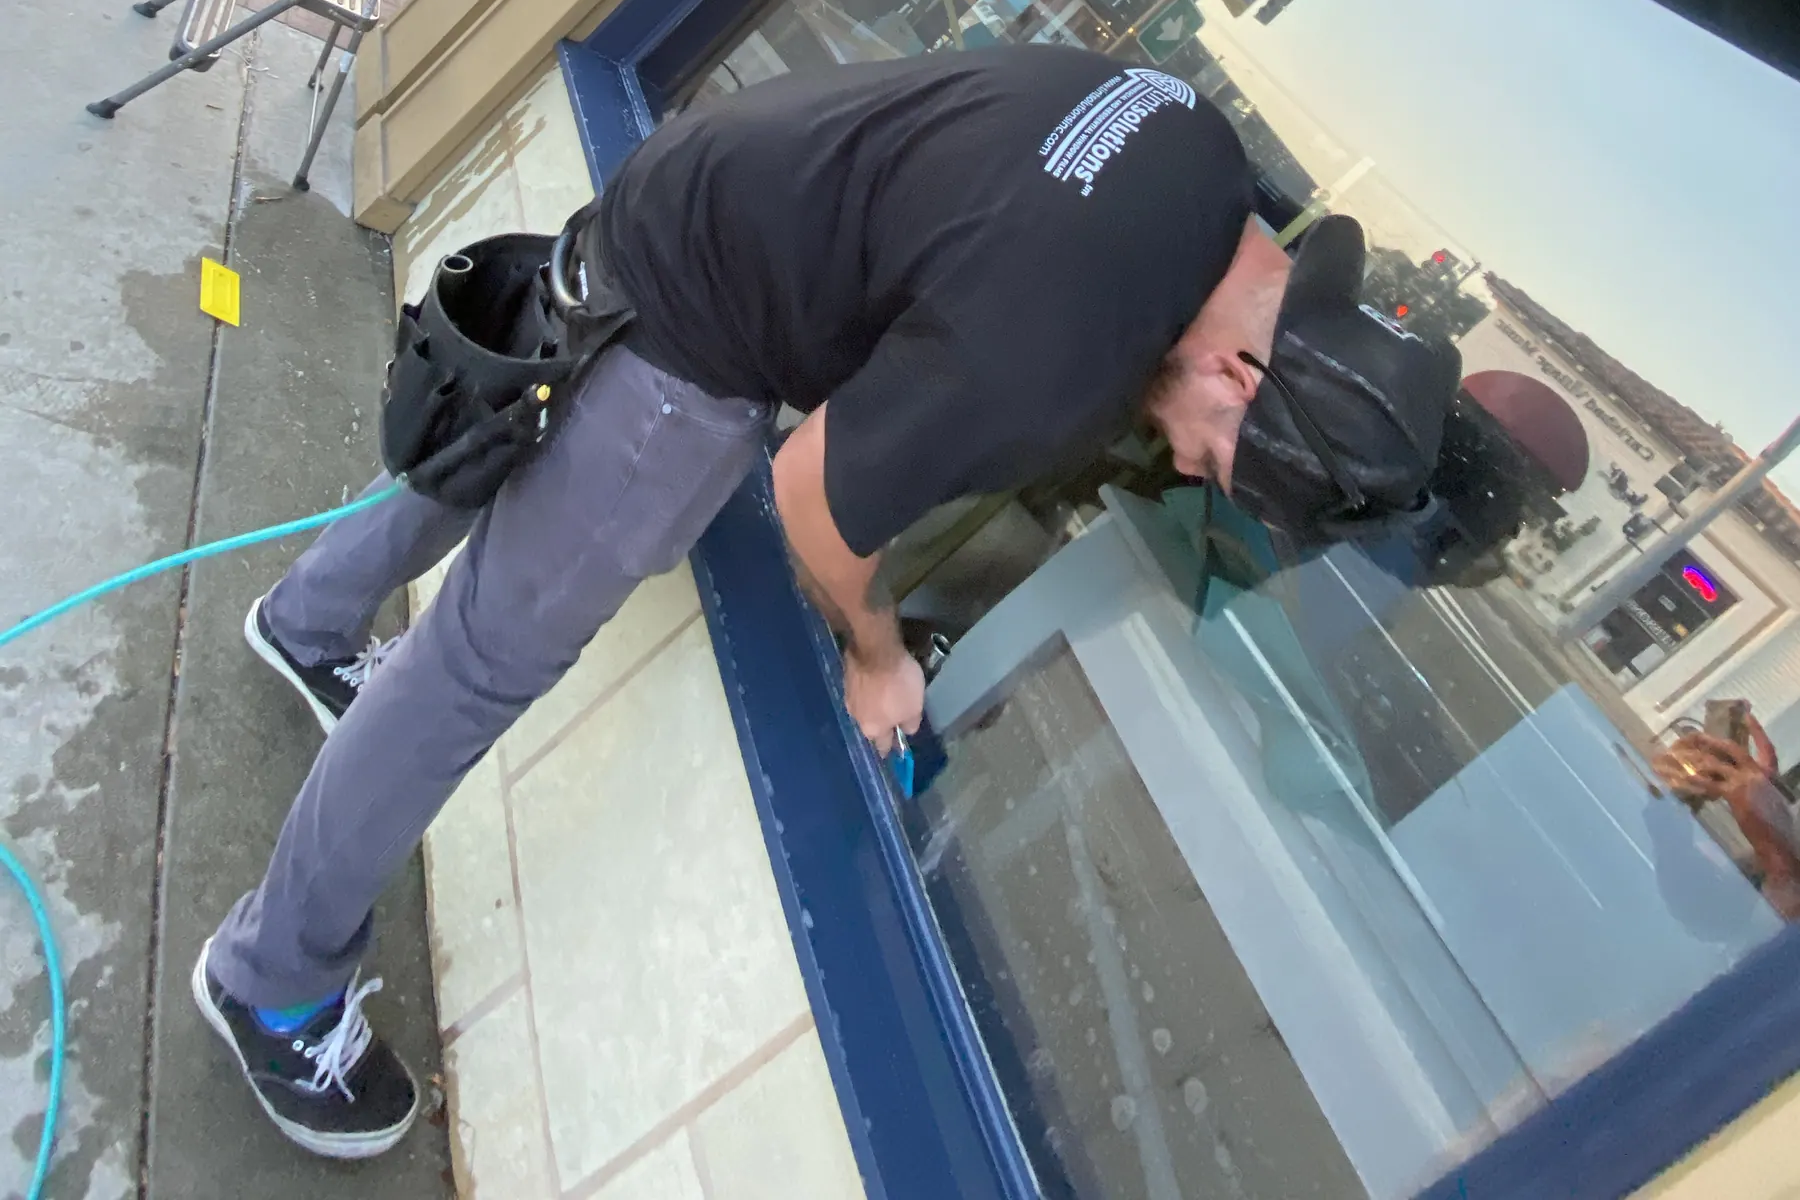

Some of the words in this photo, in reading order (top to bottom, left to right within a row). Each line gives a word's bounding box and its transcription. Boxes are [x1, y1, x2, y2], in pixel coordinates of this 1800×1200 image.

[1038, 75, 1123, 156] www.tintsolutionsinc.com
[1074, 89, 1173, 184] tintsolutions
[1053, 157, 1070, 178] FILMS
[1067, 130, 1089, 160] WINDOW
